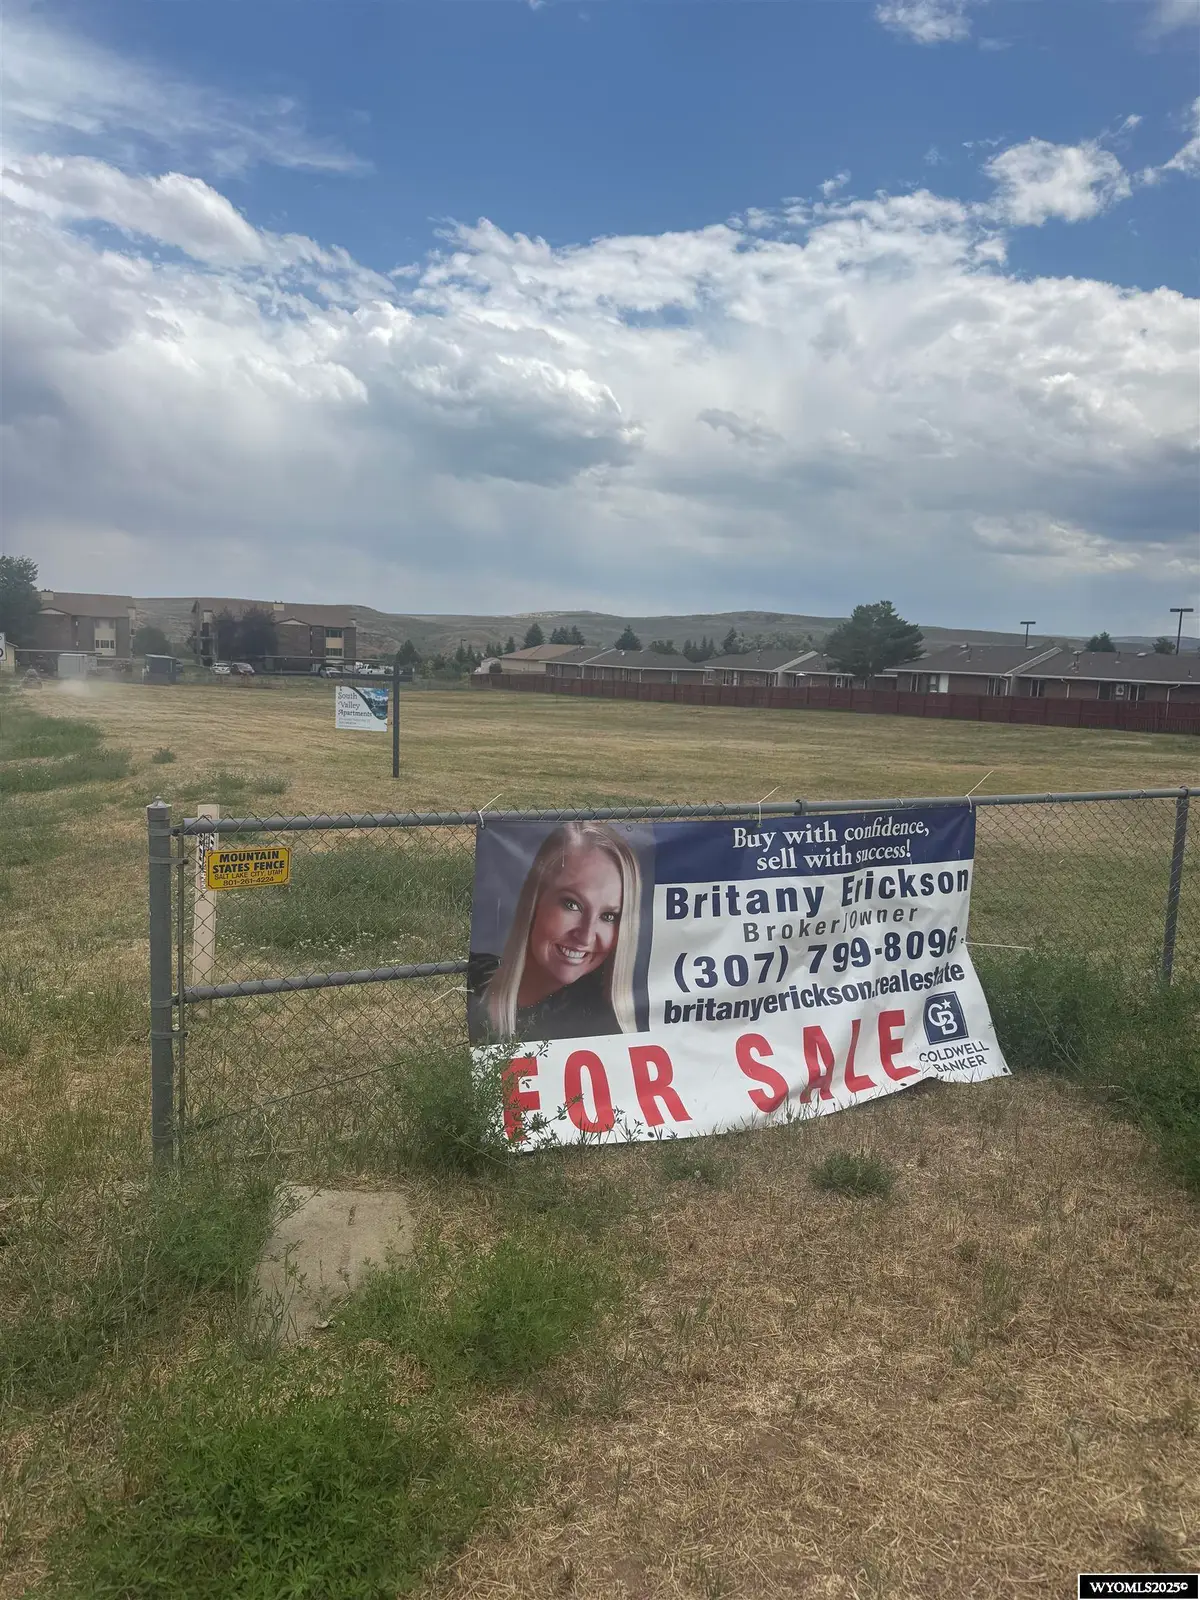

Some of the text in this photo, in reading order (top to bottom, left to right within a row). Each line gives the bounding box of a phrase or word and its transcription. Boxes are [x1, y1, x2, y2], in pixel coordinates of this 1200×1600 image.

[338, 692, 357, 700] South
[338, 701, 360, 710] Valley
[338, 709, 372, 717] Apartments
[733, 816, 930, 852] Buy with confidence,
[219, 851, 280, 863] MOUNTAIN
[756, 839, 911, 871] sell with success!
[213, 860, 285, 874] STATES FENCE
[223, 876, 274, 886] 801-261-4224
[666, 868, 969, 920] Britany Erickson
[674, 926, 958, 992] (307) 799-8096
[664, 962, 965, 1024] britanyerickson.realestate
[919, 1041, 989, 1062] COLDWELL
[933, 1054, 987, 1073] BANKER
[502, 1009, 921, 1143] FOR SALE
